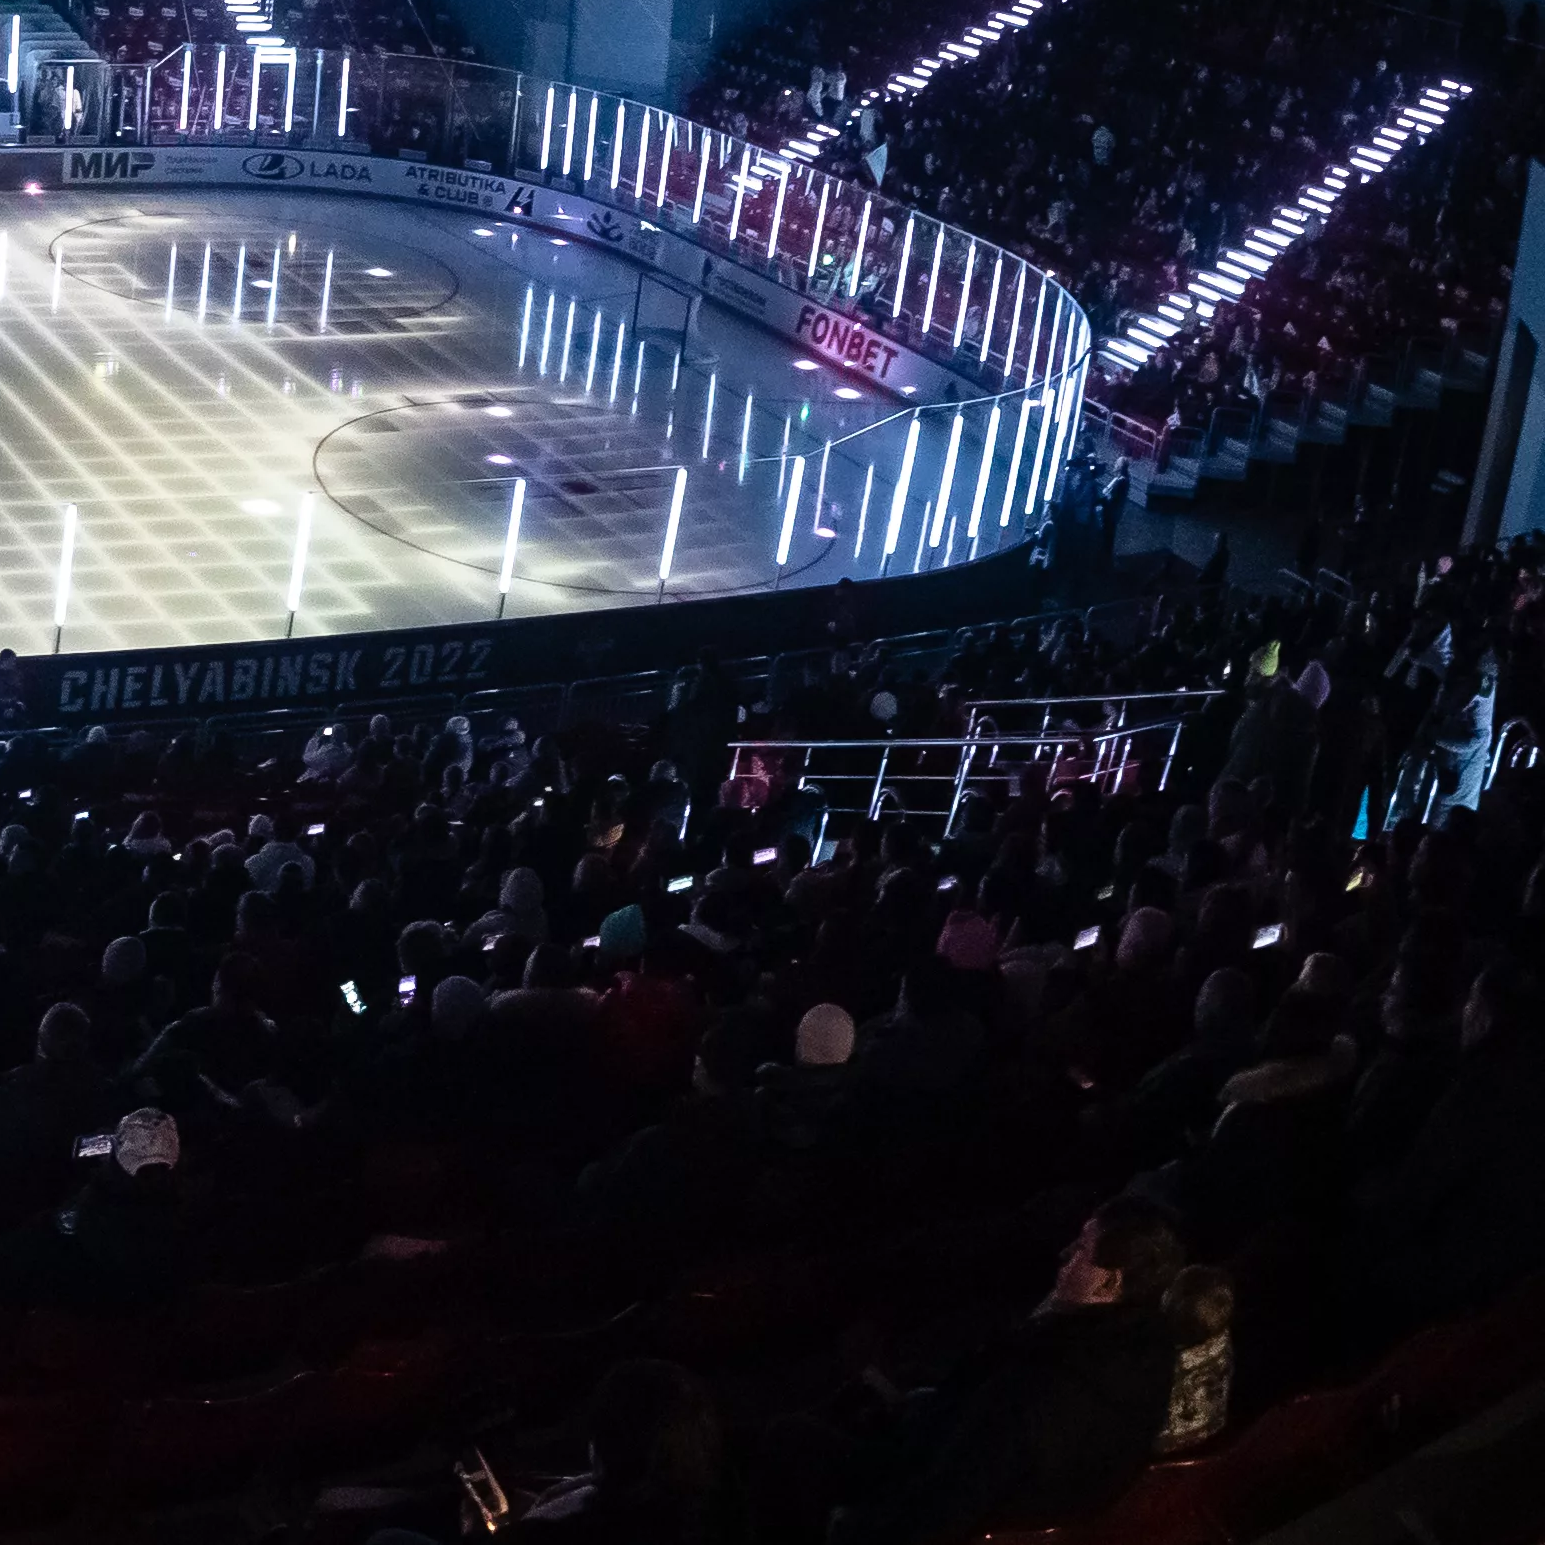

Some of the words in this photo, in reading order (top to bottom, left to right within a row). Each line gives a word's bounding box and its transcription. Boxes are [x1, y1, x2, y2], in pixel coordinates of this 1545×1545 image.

[70, 153, 156, 180] МИР
[311, 164, 372, 184] LADA
[405, 164, 507, 195] ATRIBUTIKA
[434, 186, 480, 206] CLUB
[796, 304, 899, 380] FONBET
[57, 648, 365, 713] CHELYABINSK
[378, 638, 496, 690] 2022
